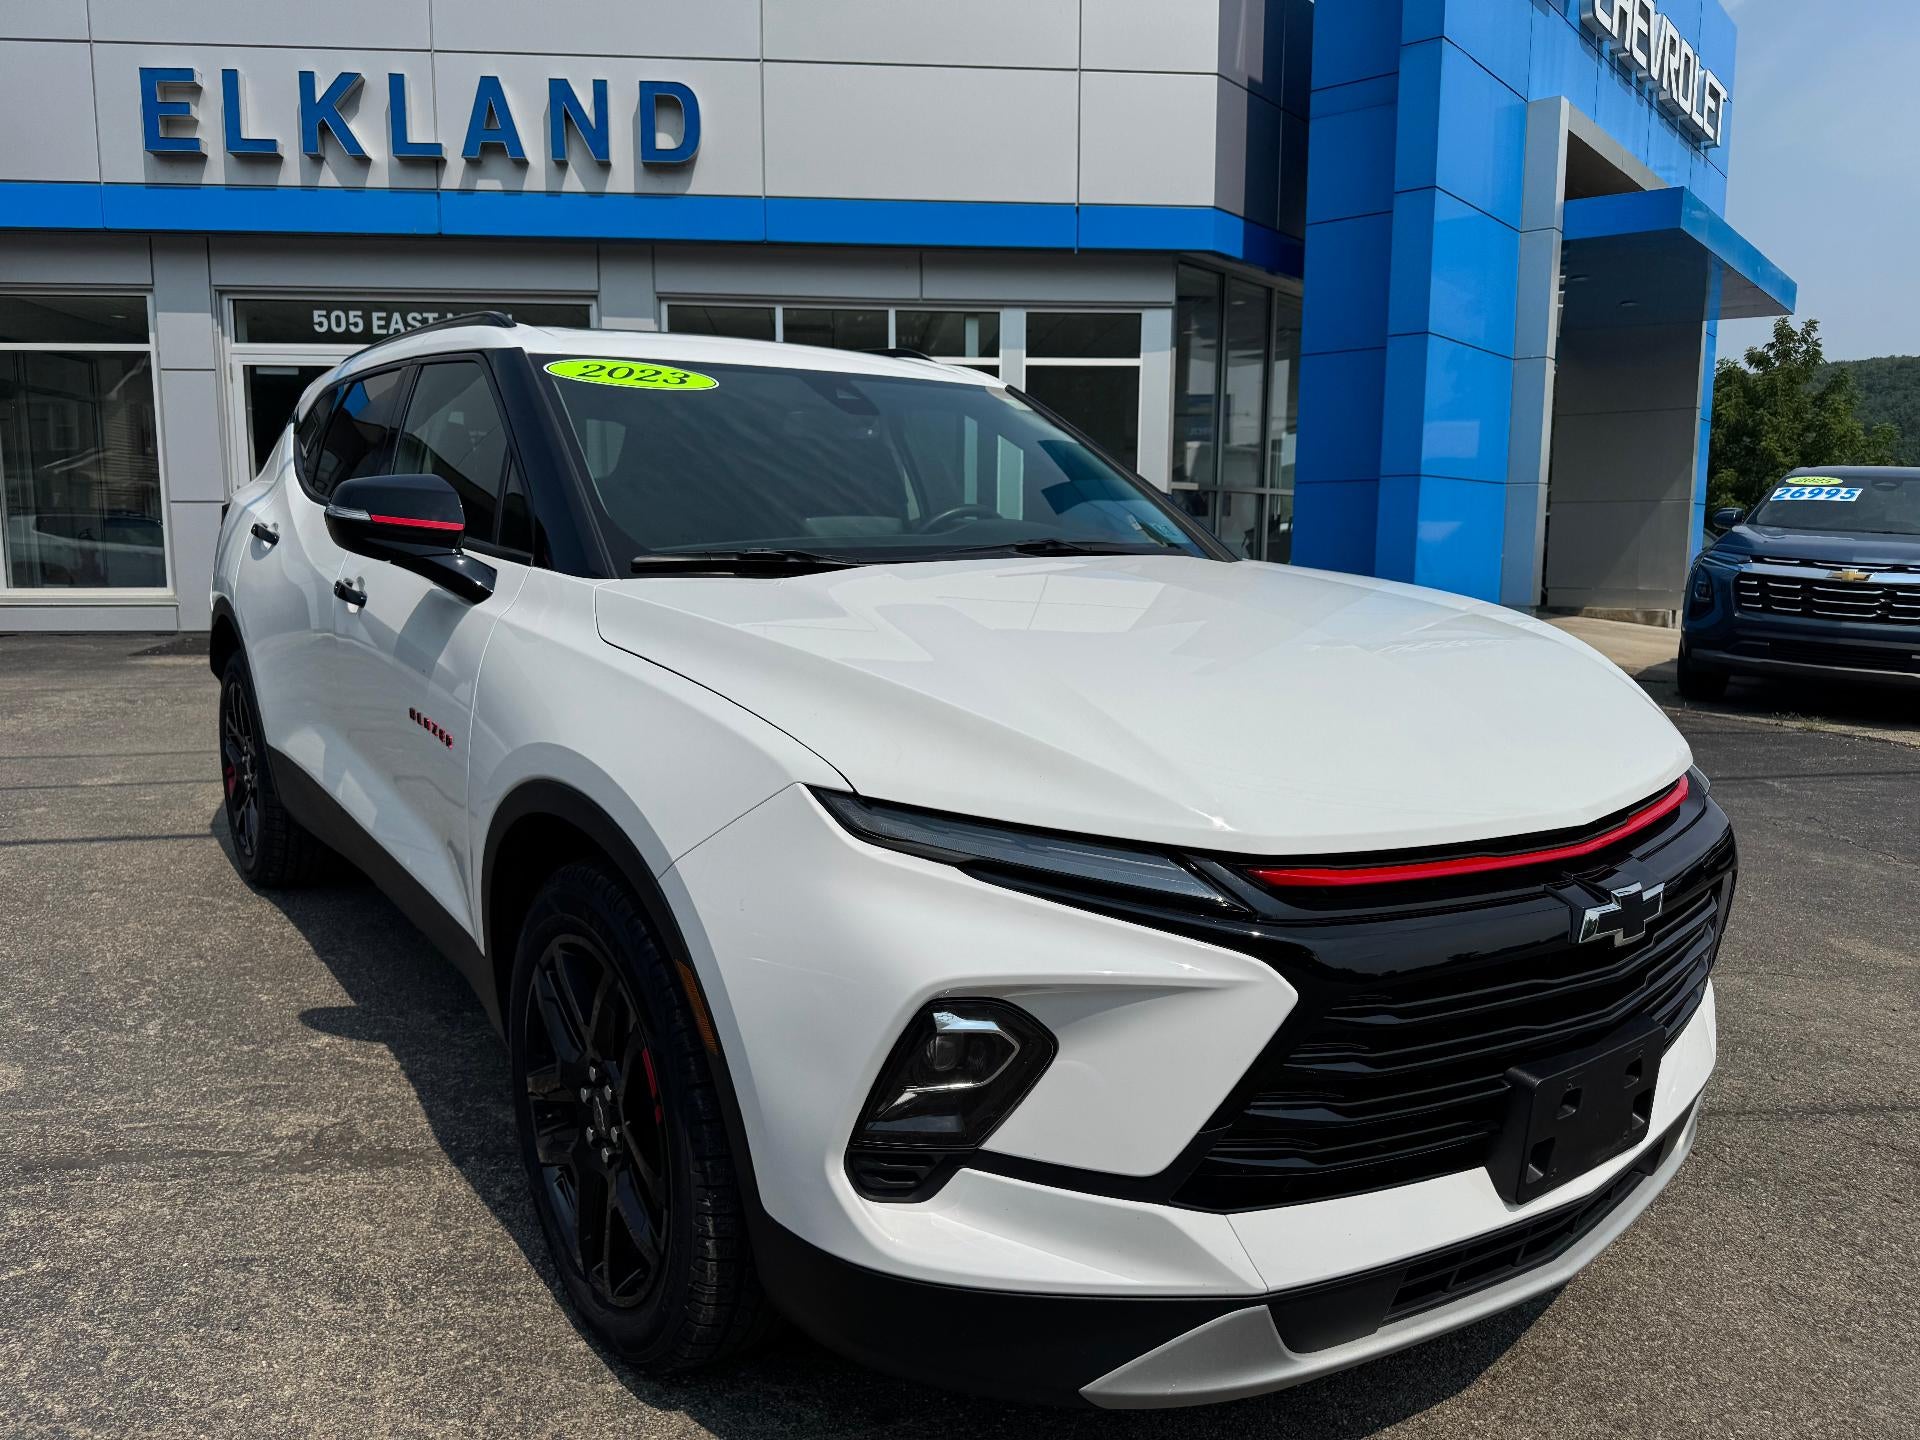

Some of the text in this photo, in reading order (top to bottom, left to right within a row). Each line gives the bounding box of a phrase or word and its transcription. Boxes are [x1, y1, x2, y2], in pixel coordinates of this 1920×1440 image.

[139, 66, 702, 166] ELKLAND
[313, 310, 364, 333] 505
[576, 363, 690, 385] 2023
[1772, 487, 1859, 499] 26995
[409, 707, 453, 750] BLAZER
